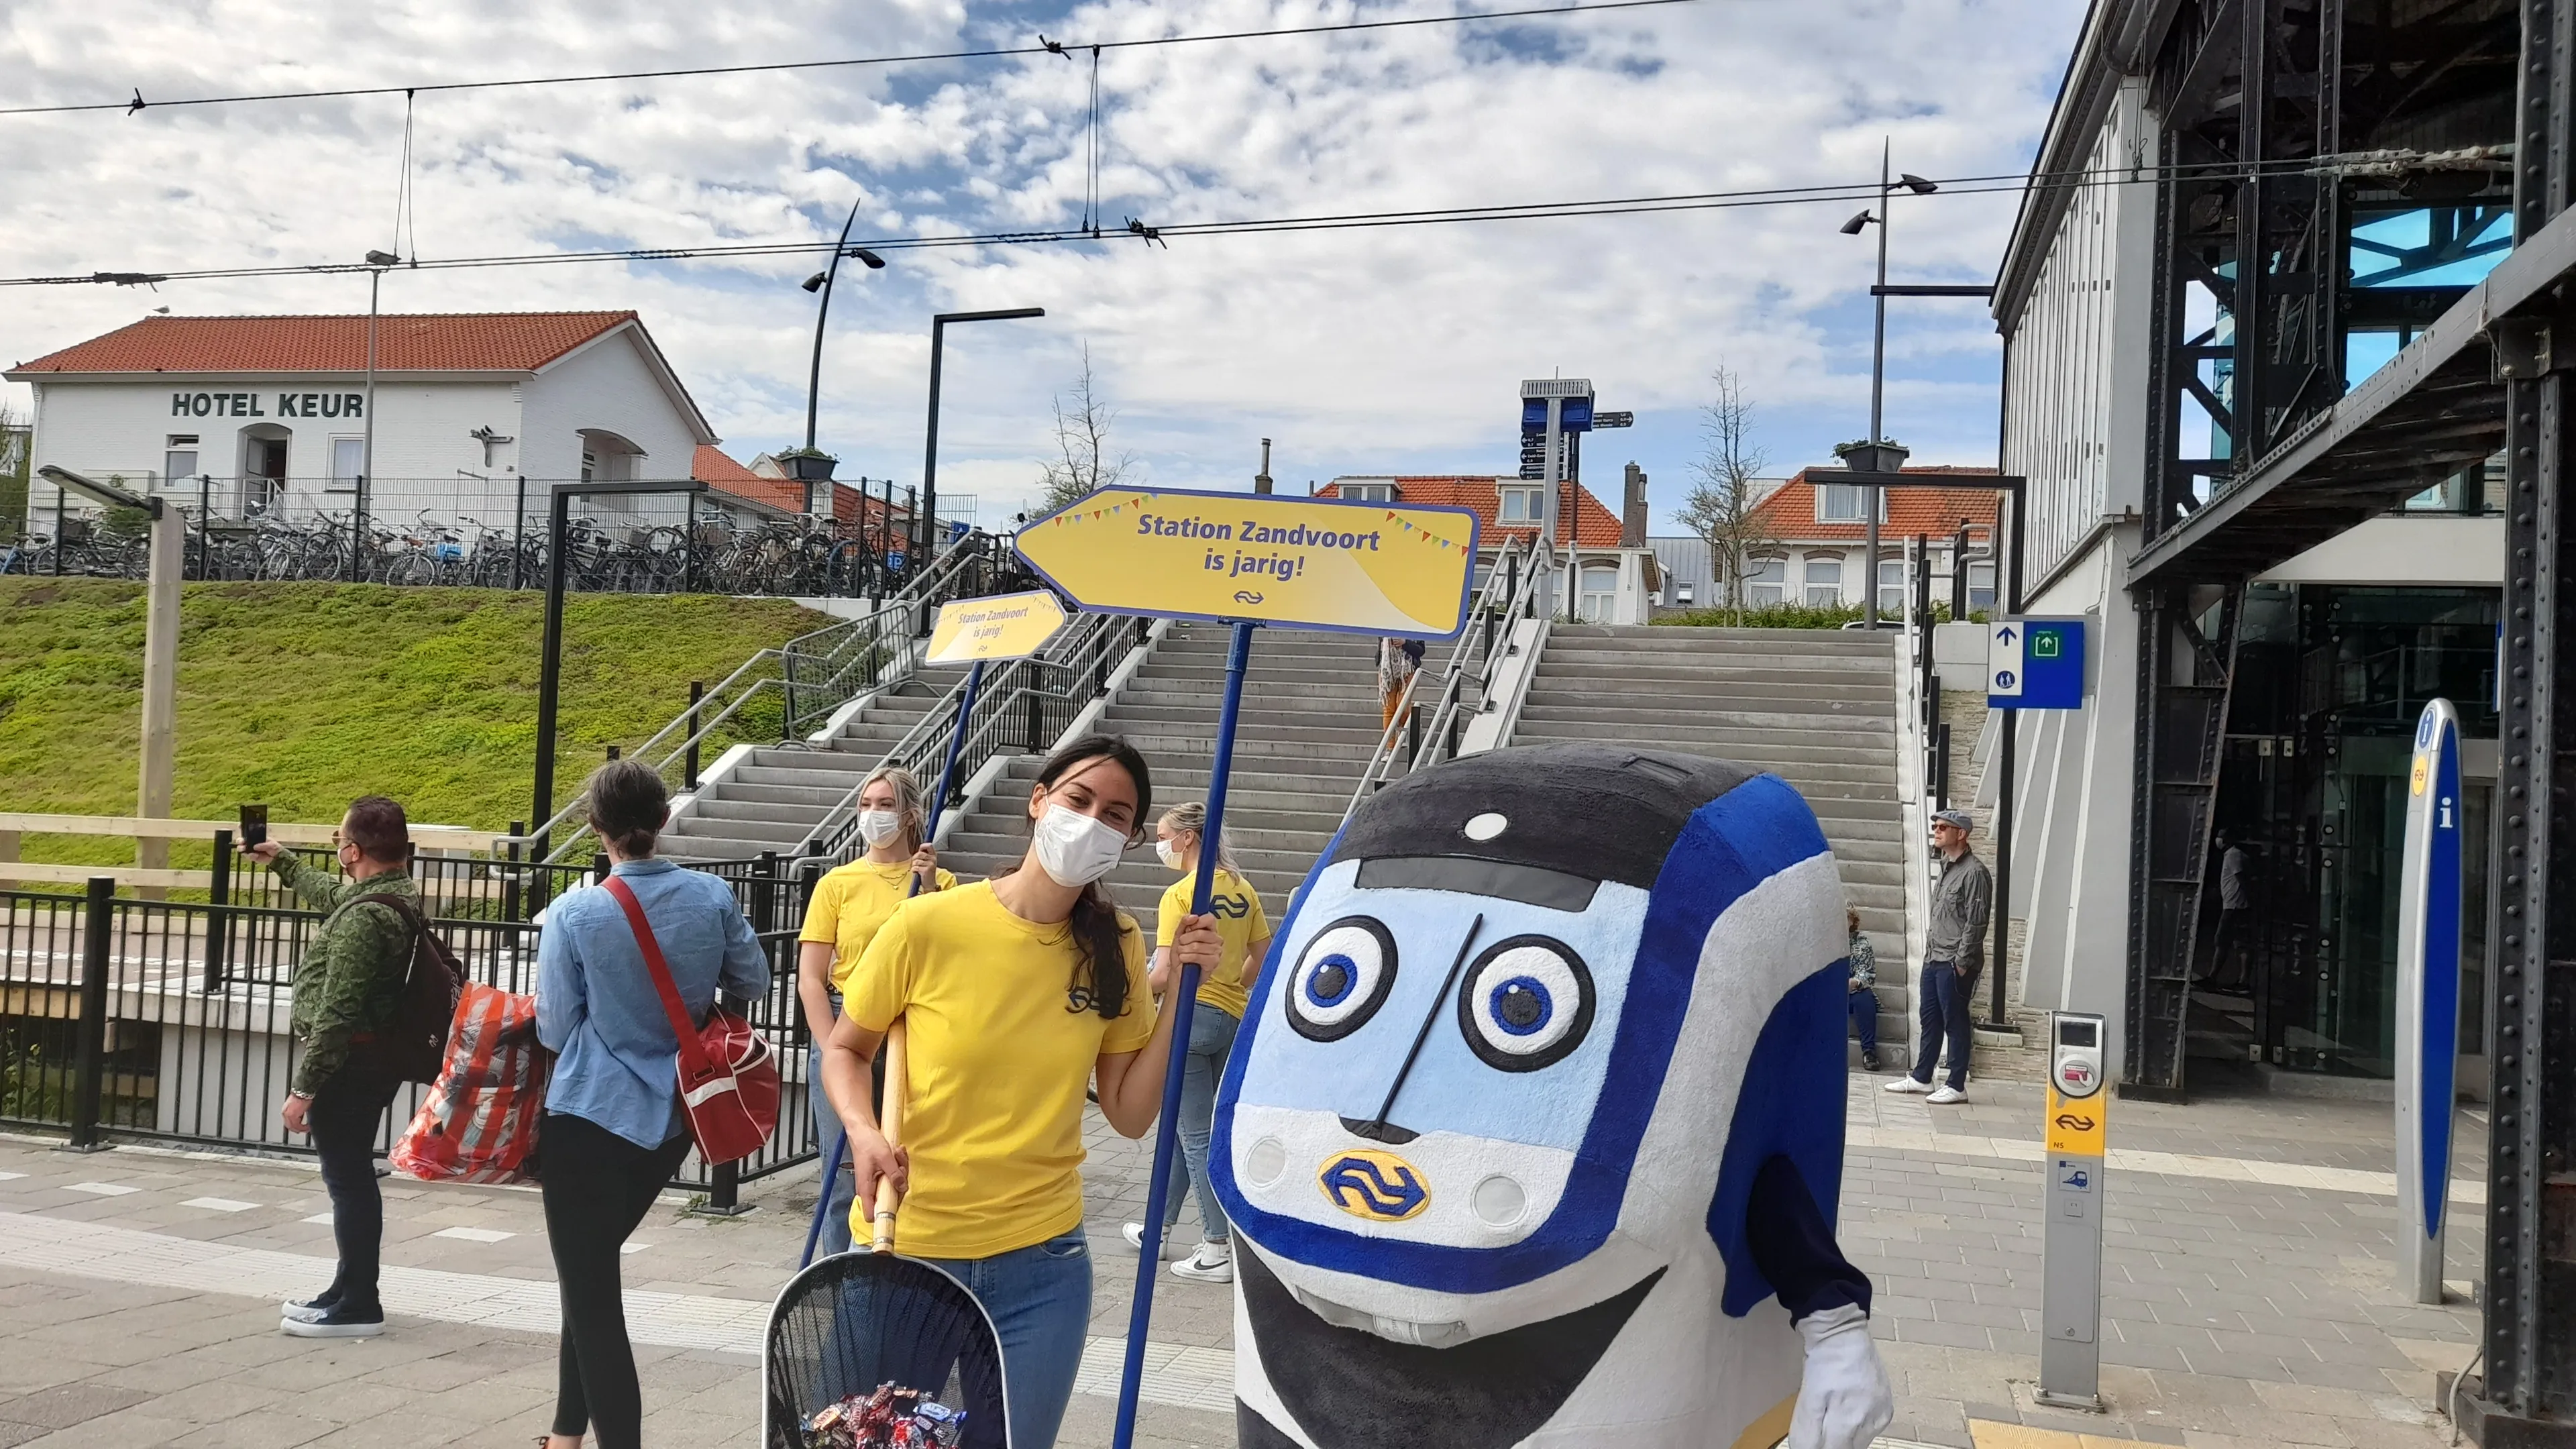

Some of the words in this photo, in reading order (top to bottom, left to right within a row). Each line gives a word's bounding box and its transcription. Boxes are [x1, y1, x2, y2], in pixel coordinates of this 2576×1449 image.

[172, 393, 264, 417] HOTEL
[278, 394, 364, 417] KEUR
[1137, 514, 1232, 540] Station
[1239, 521, 1381, 551] Zandvoort
[1204, 547, 1225, 571] is
[1229, 549, 1305, 582] jarig!
[958, 610, 985, 624] Station
[987, 606, 1028, 621] Zandvoort
[973, 625, 980, 637] is
[980, 624, 1004, 639] jarig!
